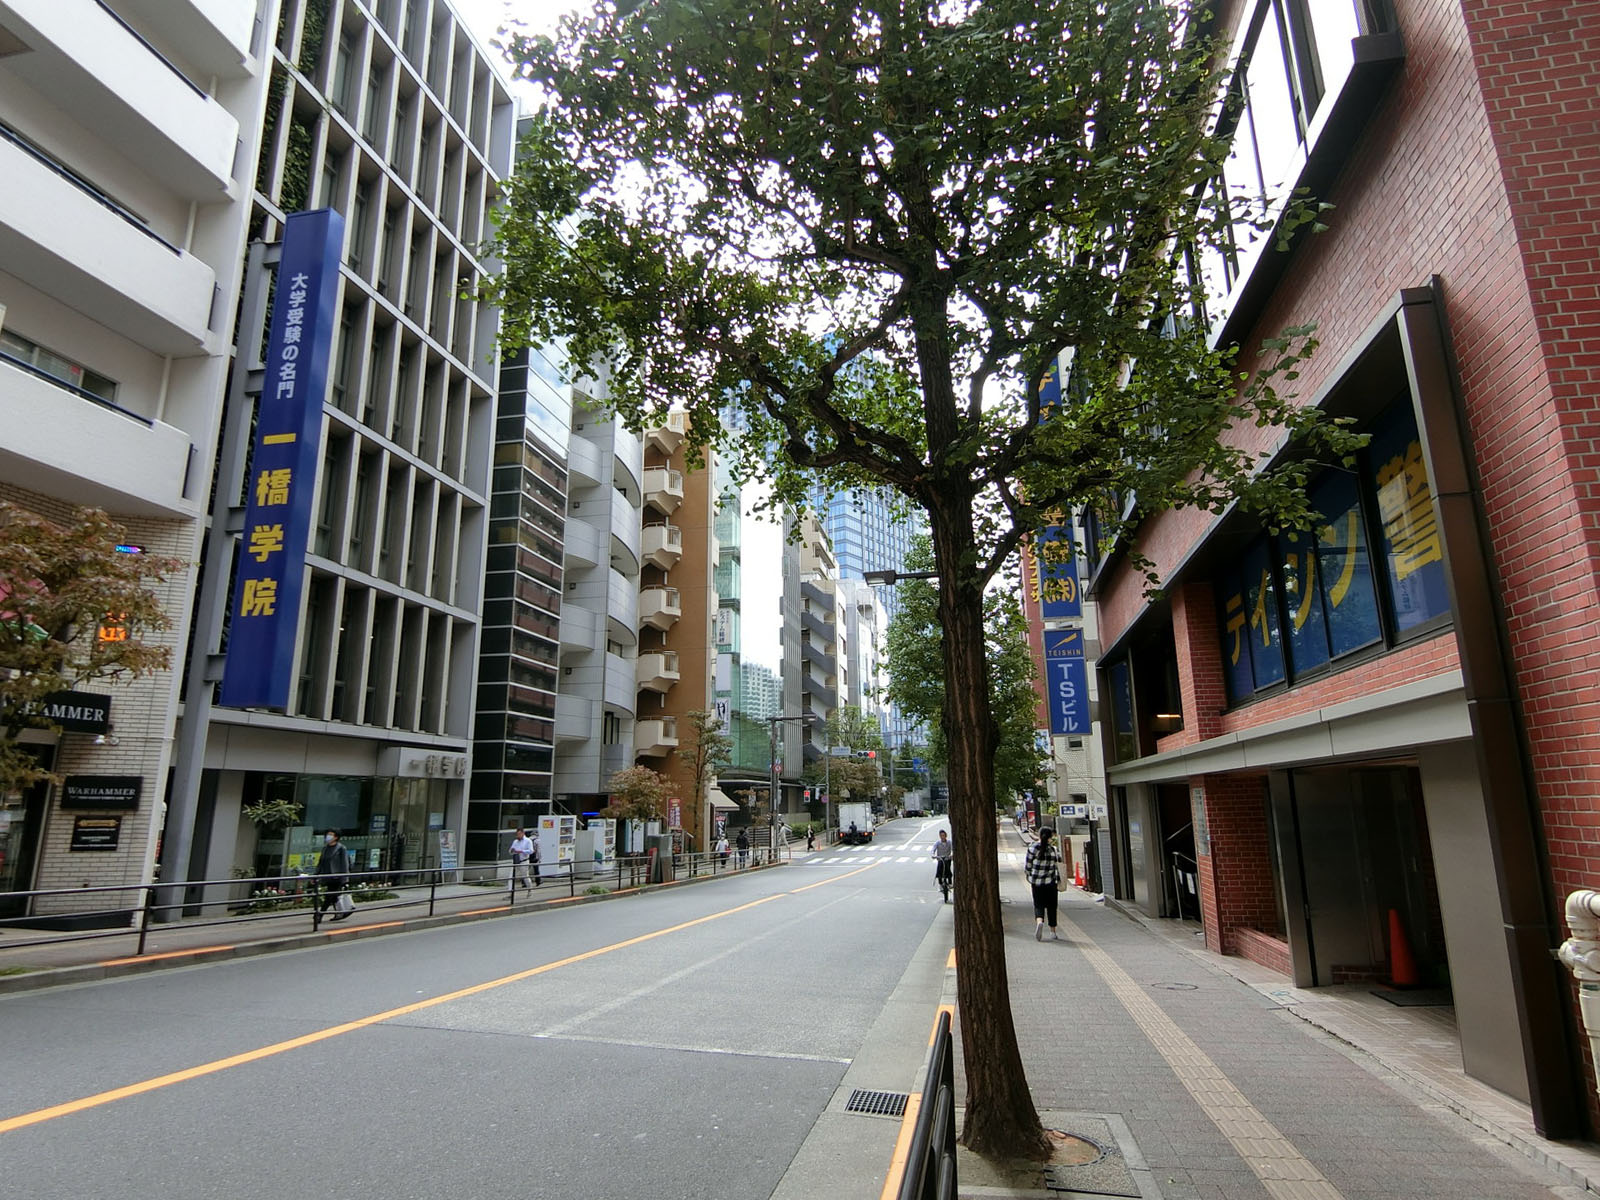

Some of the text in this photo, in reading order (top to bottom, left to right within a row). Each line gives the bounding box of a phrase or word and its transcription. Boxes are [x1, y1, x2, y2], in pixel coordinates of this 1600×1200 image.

[276, 272, 309, 400] 大学受験の名門
[240, 432, 297, 617] 一橋学院
[18, 702, 104, 722] HAMMER
[1057, 663, 1079, 732] TSビル
[67, 786, 136, 796] WARHAMMER
